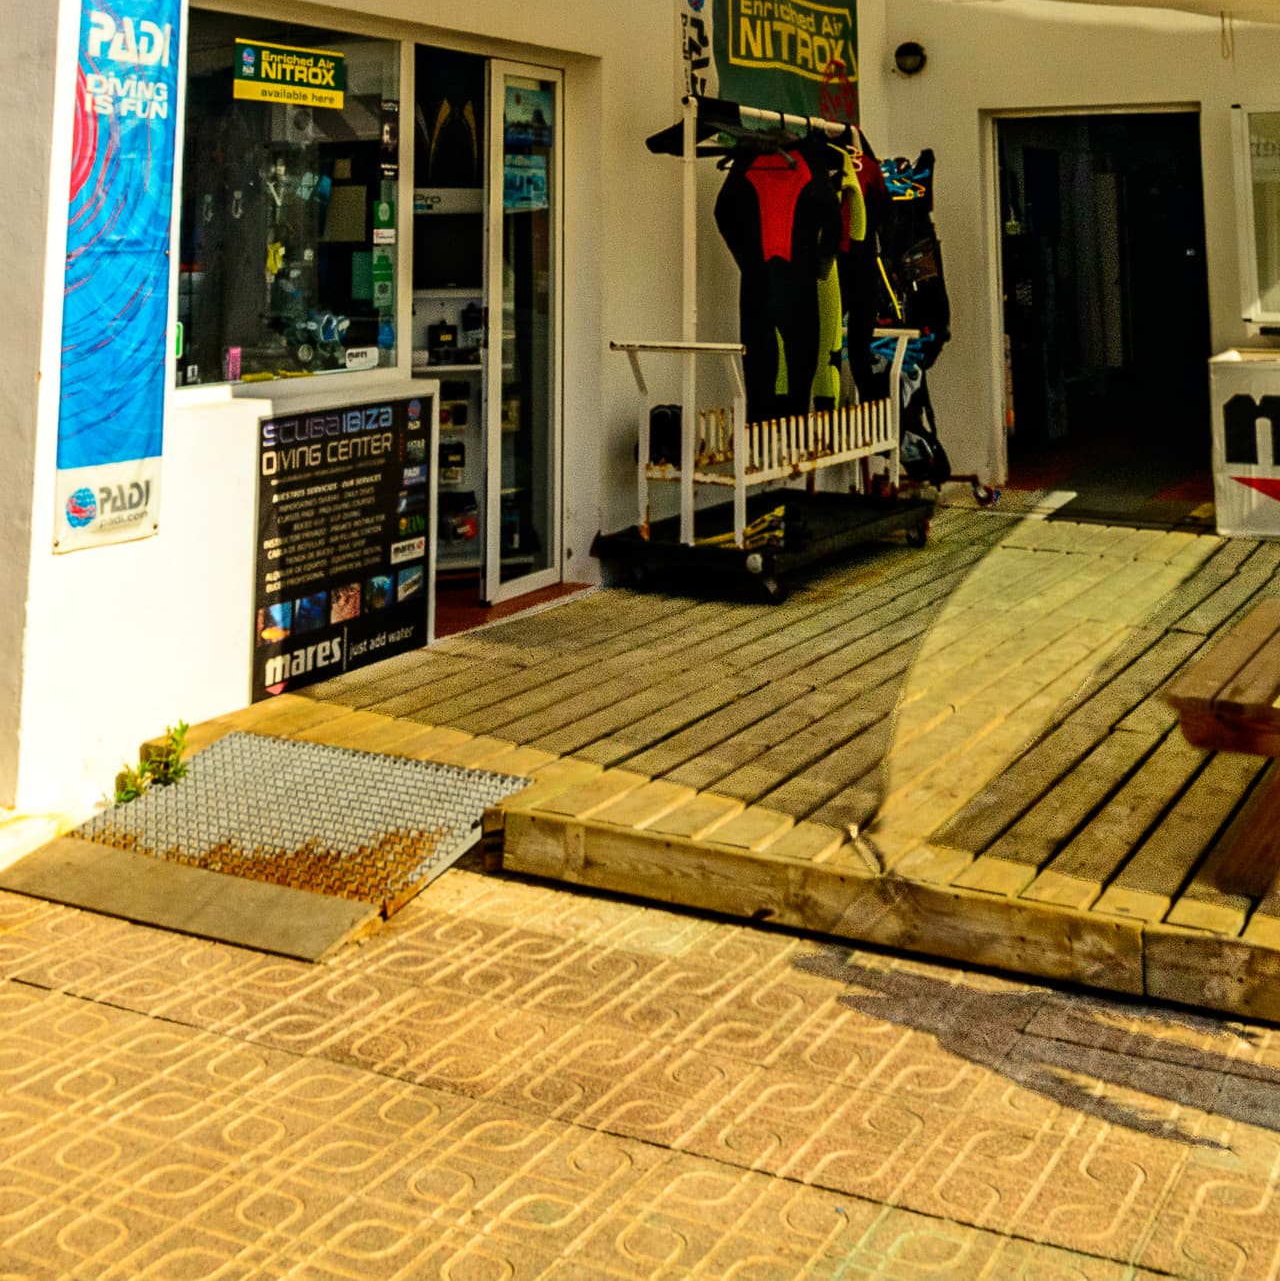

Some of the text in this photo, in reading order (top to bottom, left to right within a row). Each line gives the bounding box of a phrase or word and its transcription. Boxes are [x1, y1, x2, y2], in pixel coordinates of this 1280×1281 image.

[87, 12, 172, 68] PADI
[822, 17, 844, 38] Air
[261, 50, 335, 69] Enriched Air
[740, 18, 845, 74] NITROX
[86, 72, 168, 103] DIVING
[261, 62, 336, 87] NITROX
[84, 90, 168, 119] IS FUN
[261, 88, 335, 104] available here
[262, 443, 322, 475] DIVING
[327, 432, 393, 464] CENTER
[99, 480, 150, 515] PADI
[265, 624, 415, 687] mares just add water
